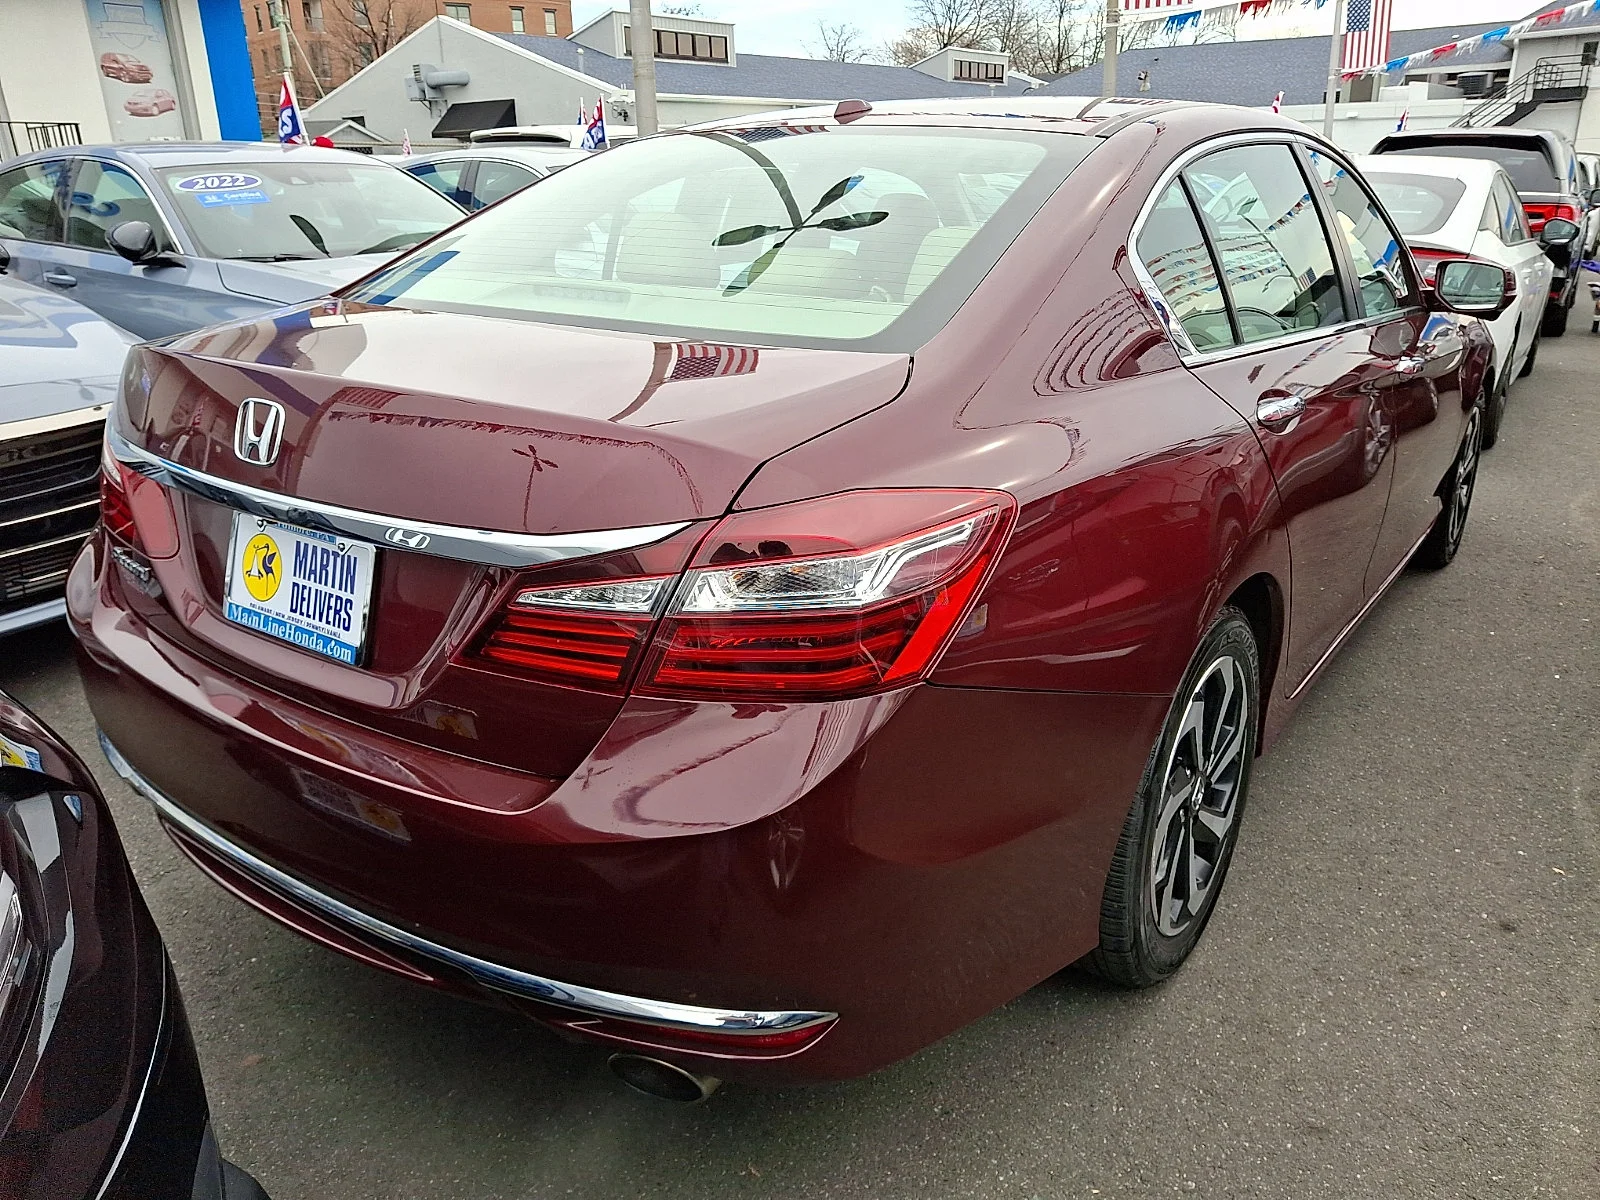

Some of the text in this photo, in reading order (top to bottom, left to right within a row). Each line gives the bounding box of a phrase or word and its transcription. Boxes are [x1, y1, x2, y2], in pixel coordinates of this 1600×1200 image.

[193, 175, 246, 190] 2022
[293, 540, 358, 595] MARTIN
[275, 611, 286, 620] NEW
[289, 581, 354, 633] DELIVERS
[229, 604, 352, 663] MainLineHonda.com
